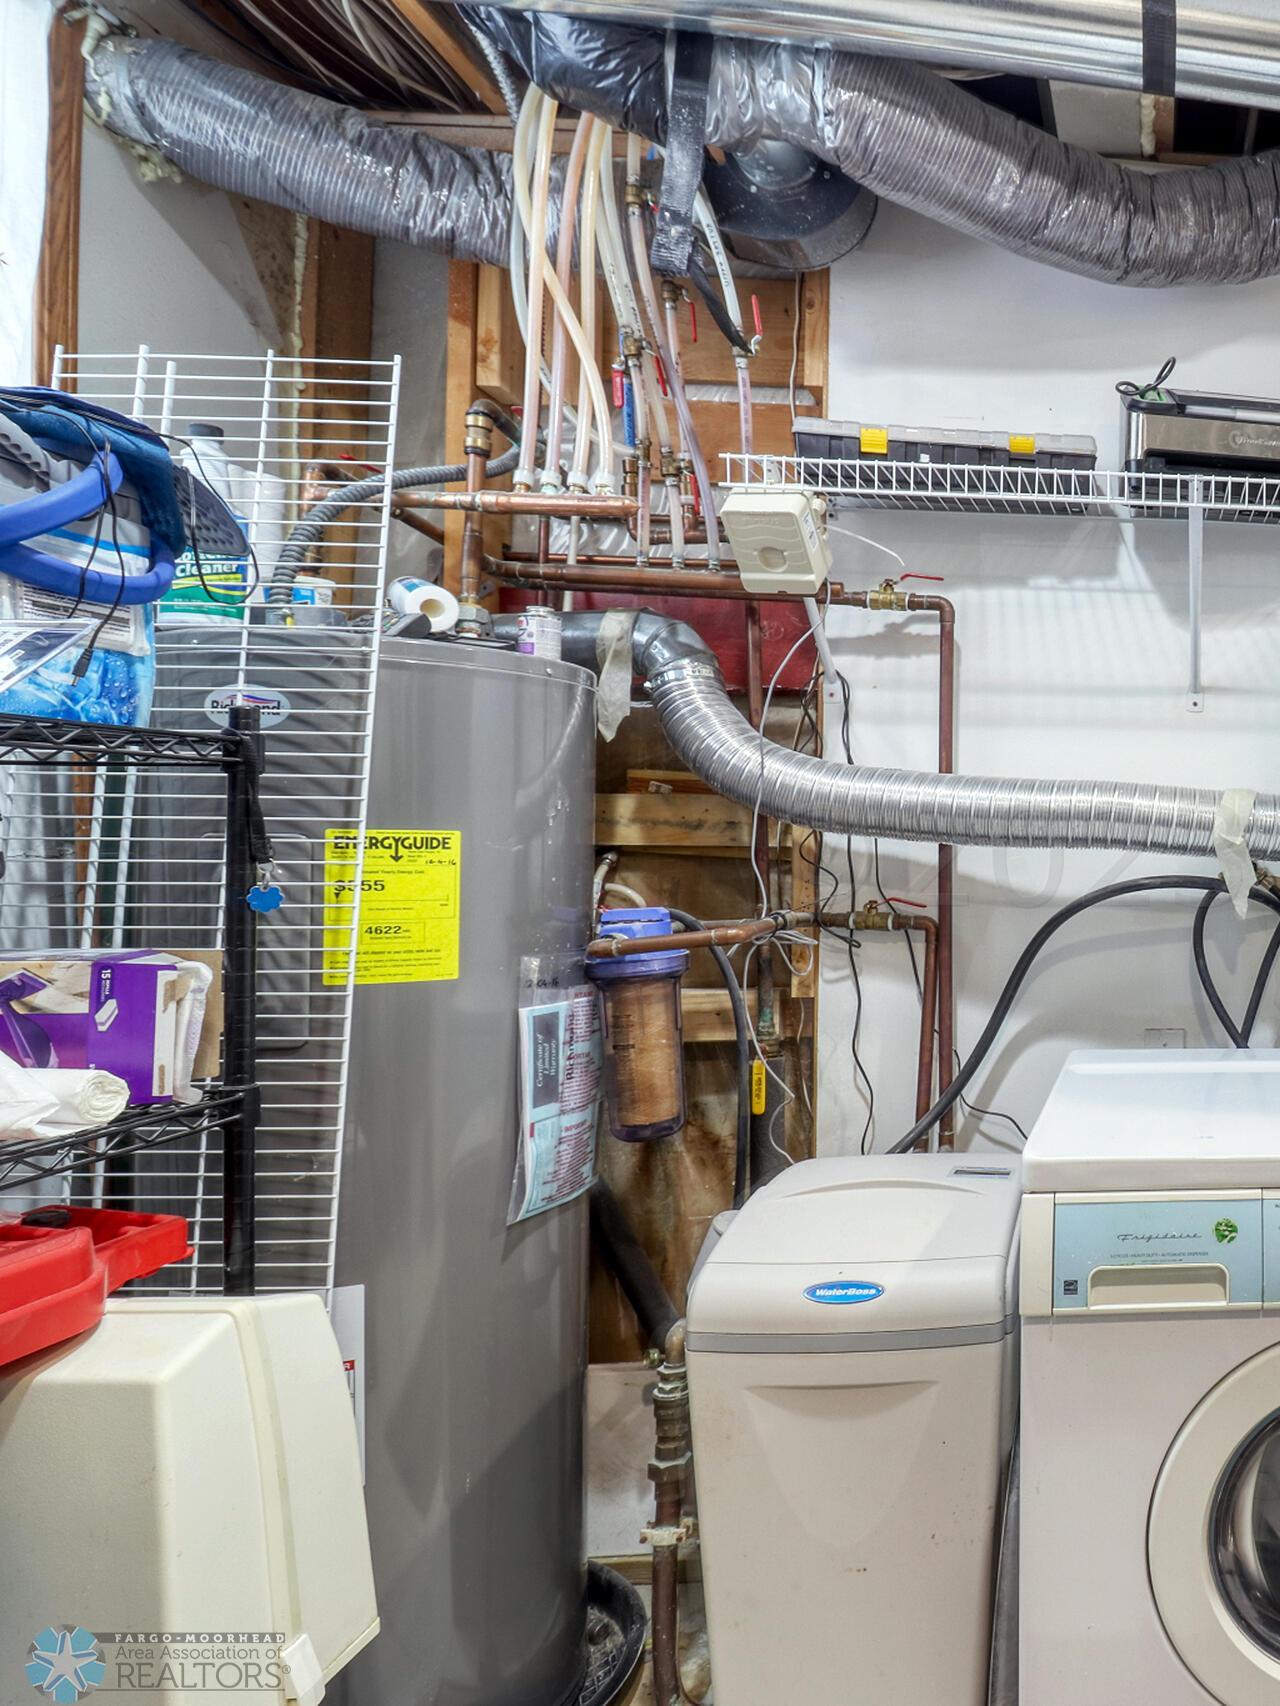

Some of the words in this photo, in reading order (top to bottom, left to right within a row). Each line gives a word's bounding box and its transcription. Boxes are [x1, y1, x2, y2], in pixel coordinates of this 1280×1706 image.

[175, 562, 238, 578] Cleaner
[210, 699, 281, 716] Ricond
[364, 925, 403, 935] 4622
[101, 968, 112, 980] 15
[549, 1039, 558, 1077] Warranty
[535, 1044, 545, 1088] Certificate
[1116, 1232, 1203, 1242] Frigidaire
[815, 1287, 877, 1297] WaterBoss
